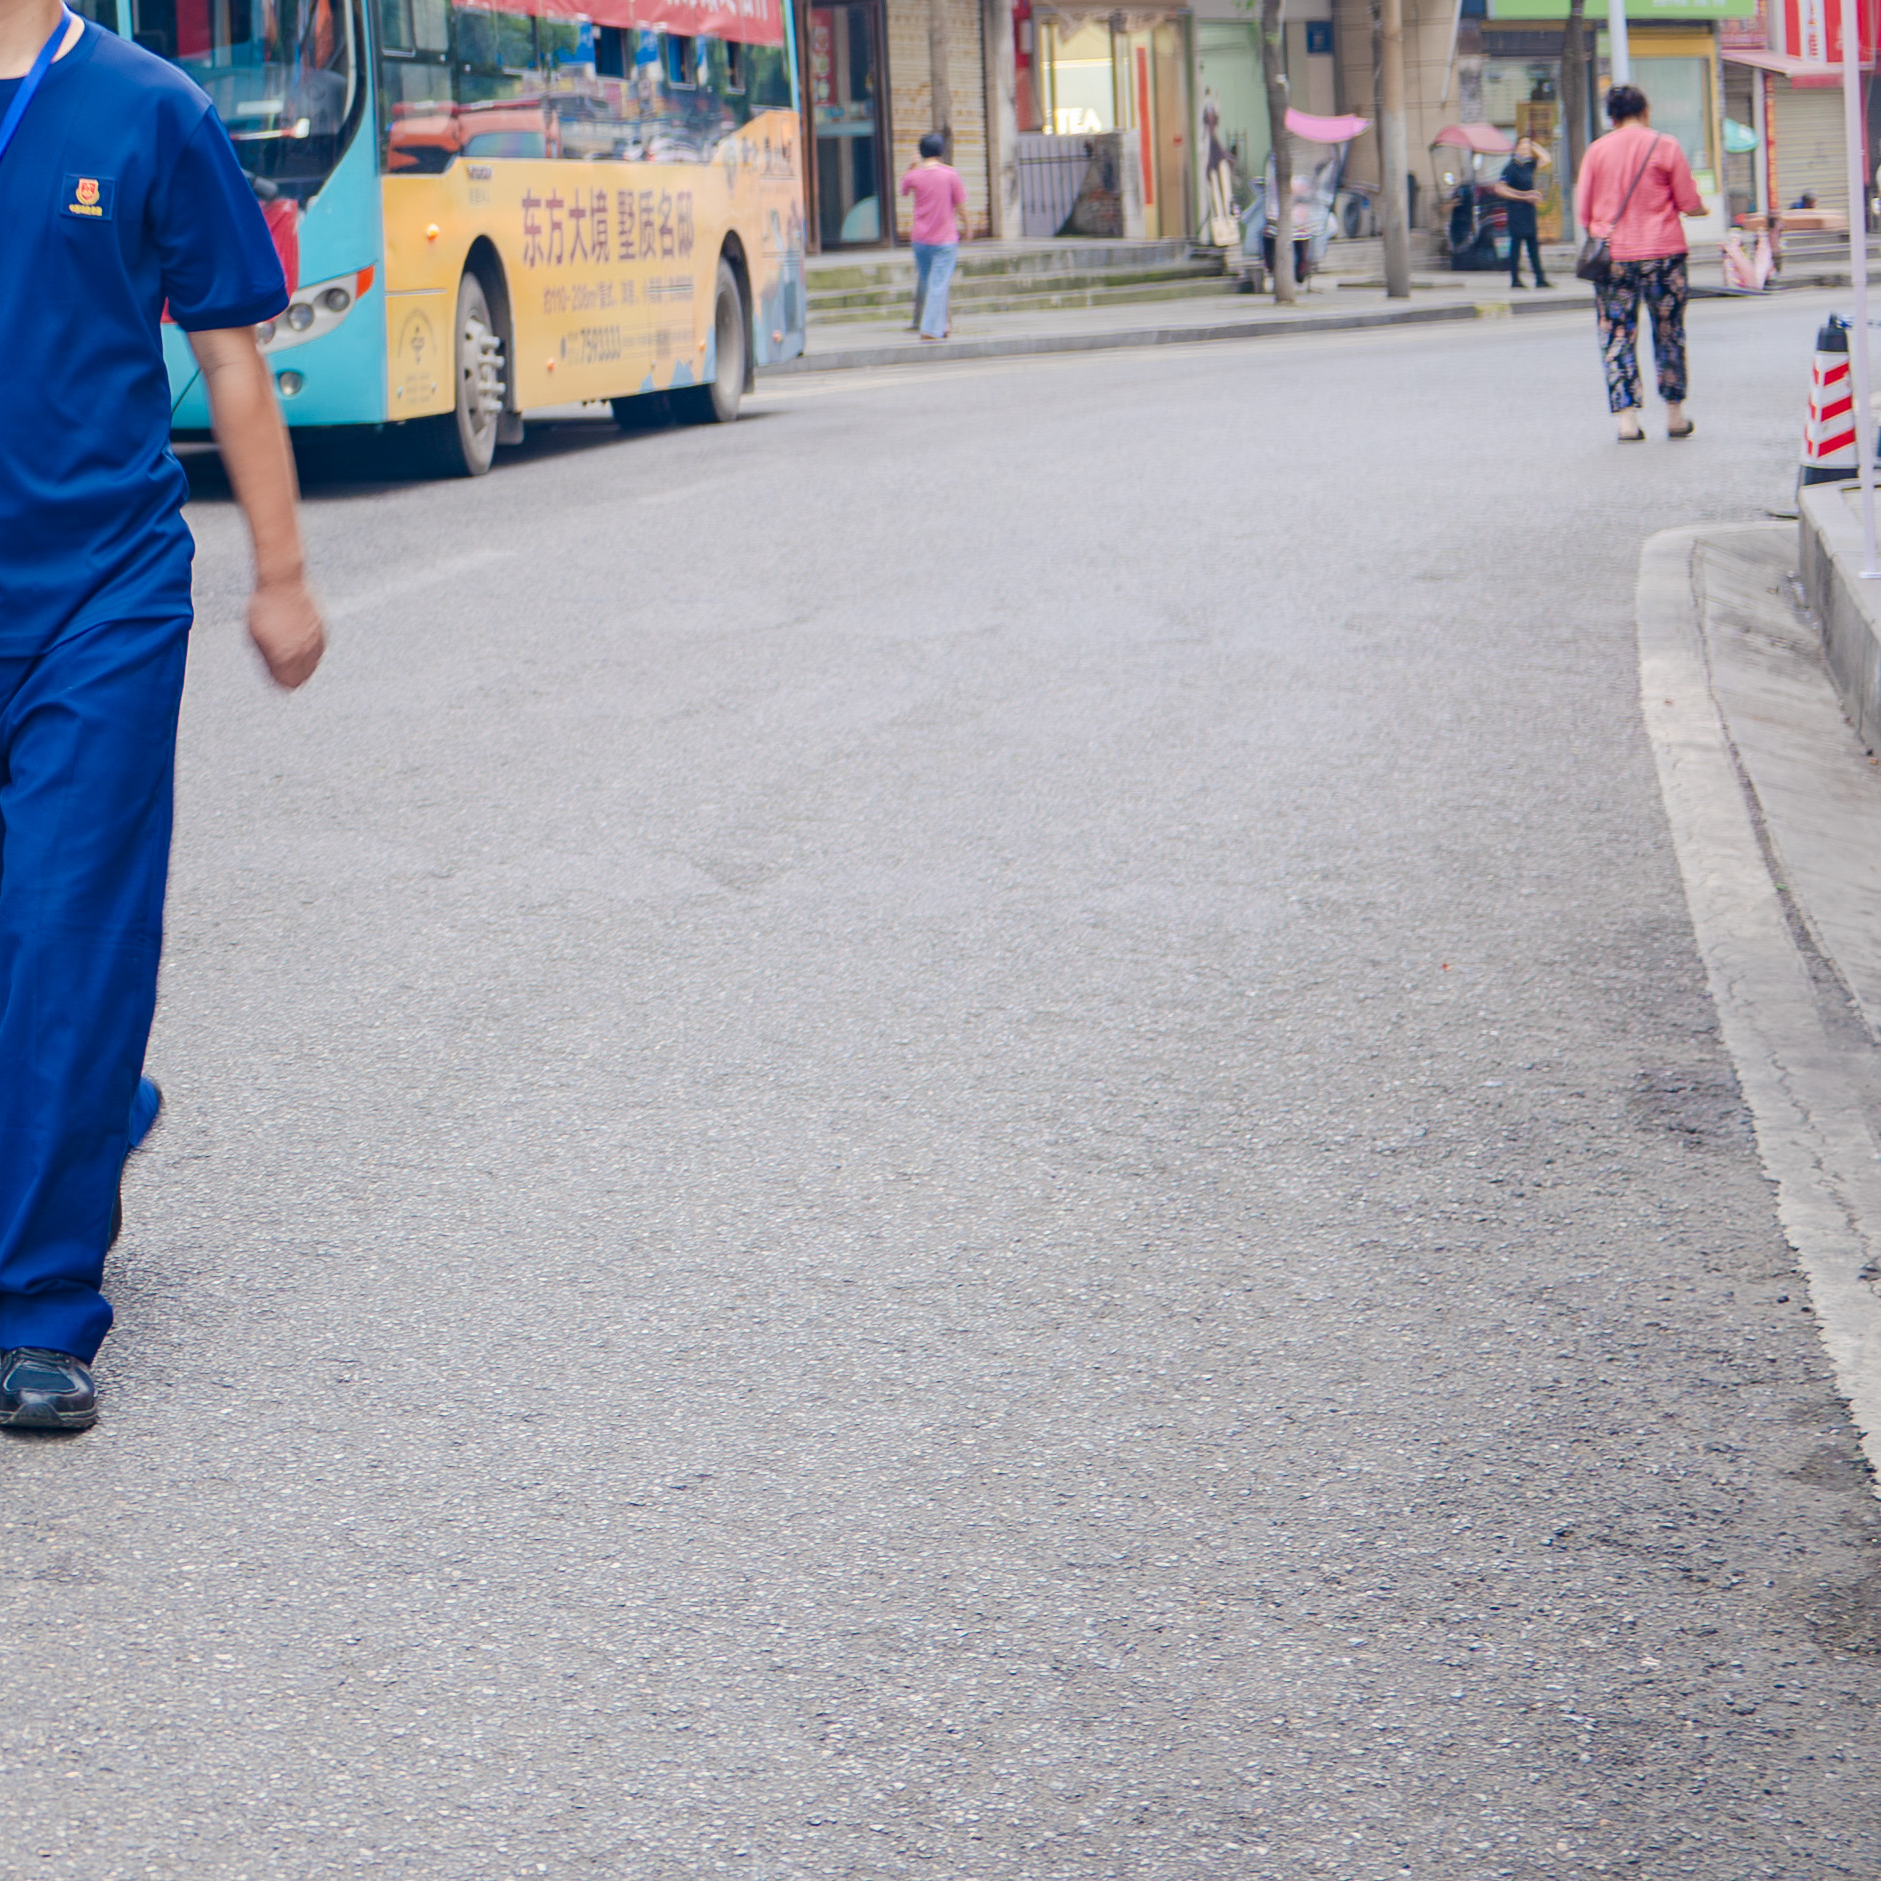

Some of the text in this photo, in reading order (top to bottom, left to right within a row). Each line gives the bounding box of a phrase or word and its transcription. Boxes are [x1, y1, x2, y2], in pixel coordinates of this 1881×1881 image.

[521, 187, 695, 269] 东方大境 墅质名邸
